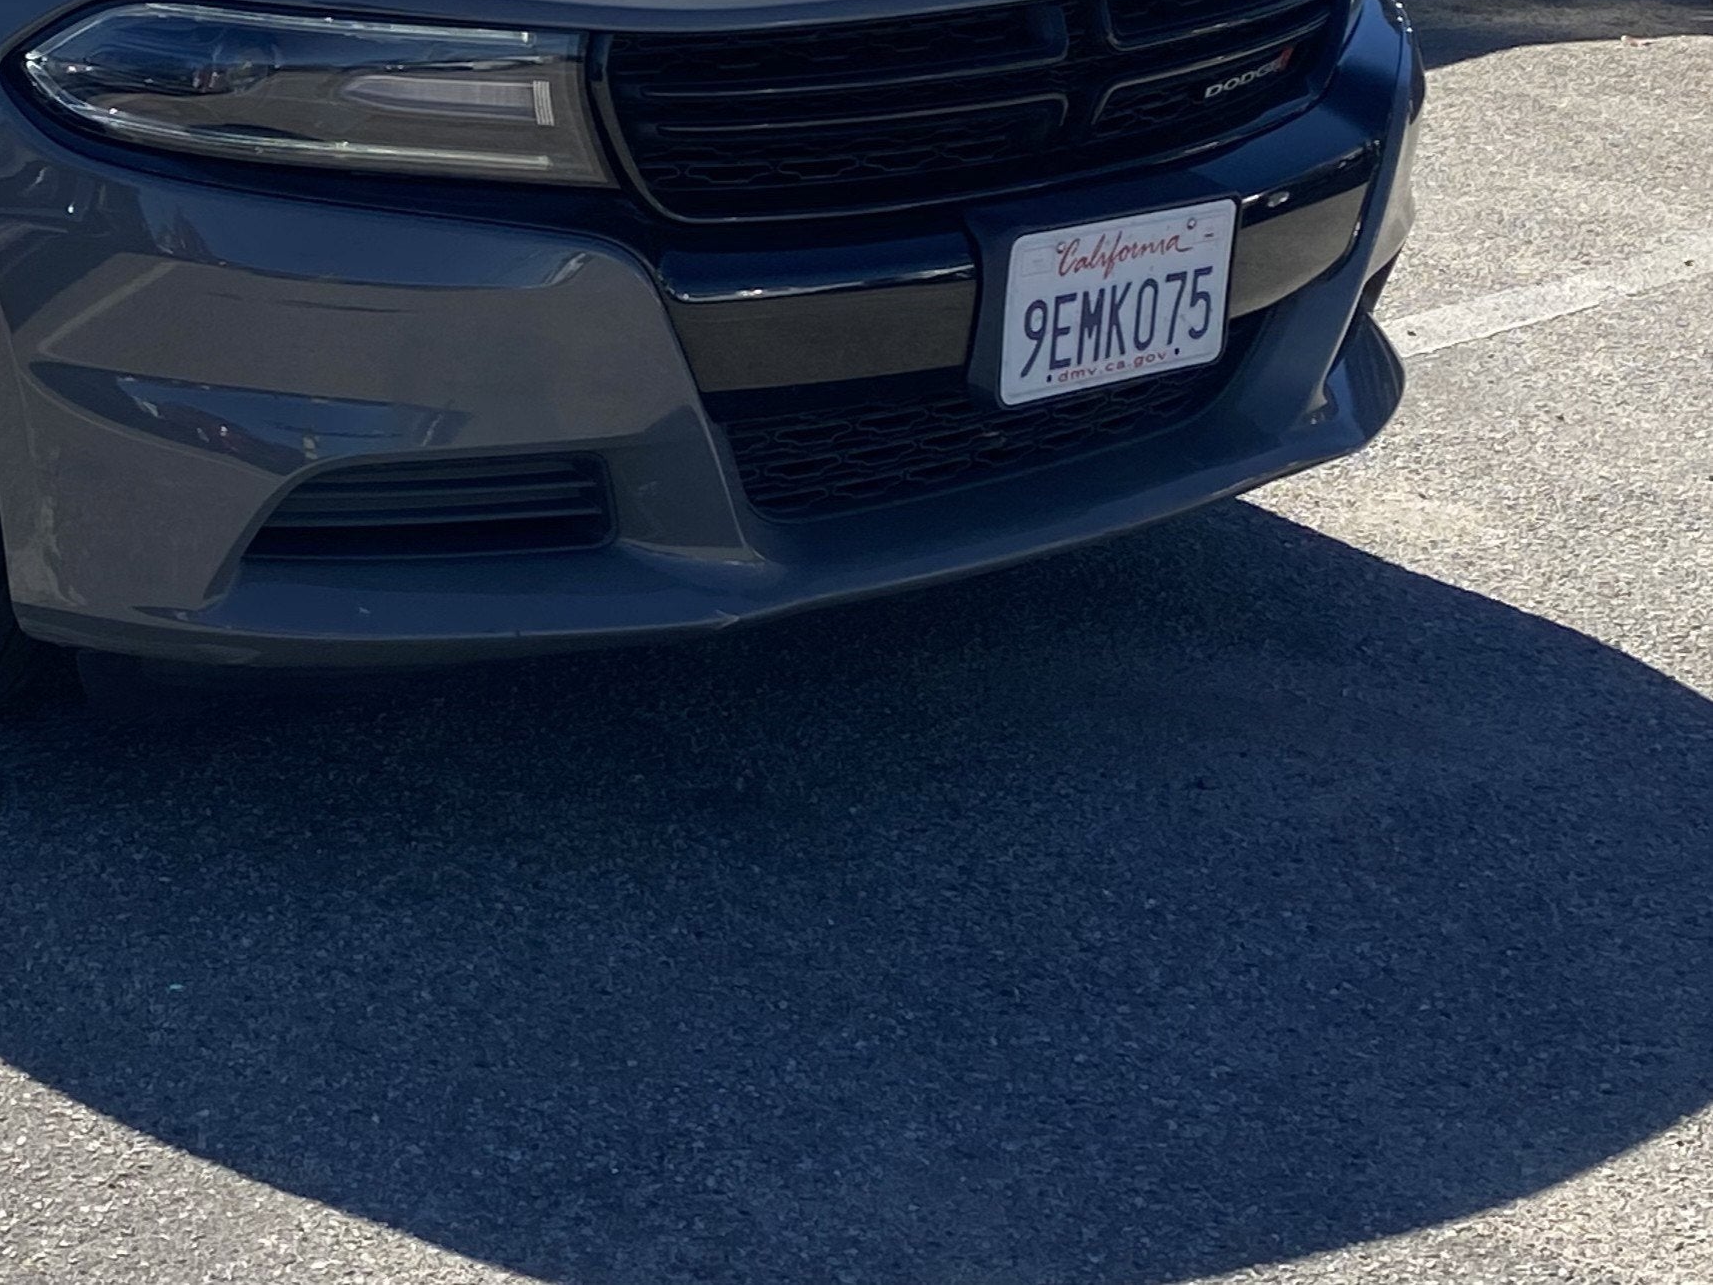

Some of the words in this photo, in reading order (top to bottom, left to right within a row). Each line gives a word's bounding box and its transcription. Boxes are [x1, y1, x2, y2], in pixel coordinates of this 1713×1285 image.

[1205, 58, 1283, 98] DODGE
[1058, 231, 1194, 279] California
[1020, 266, 1214, 379] 9EMK075
[1058, 350, 1168, 383] dmv.ca.gov
